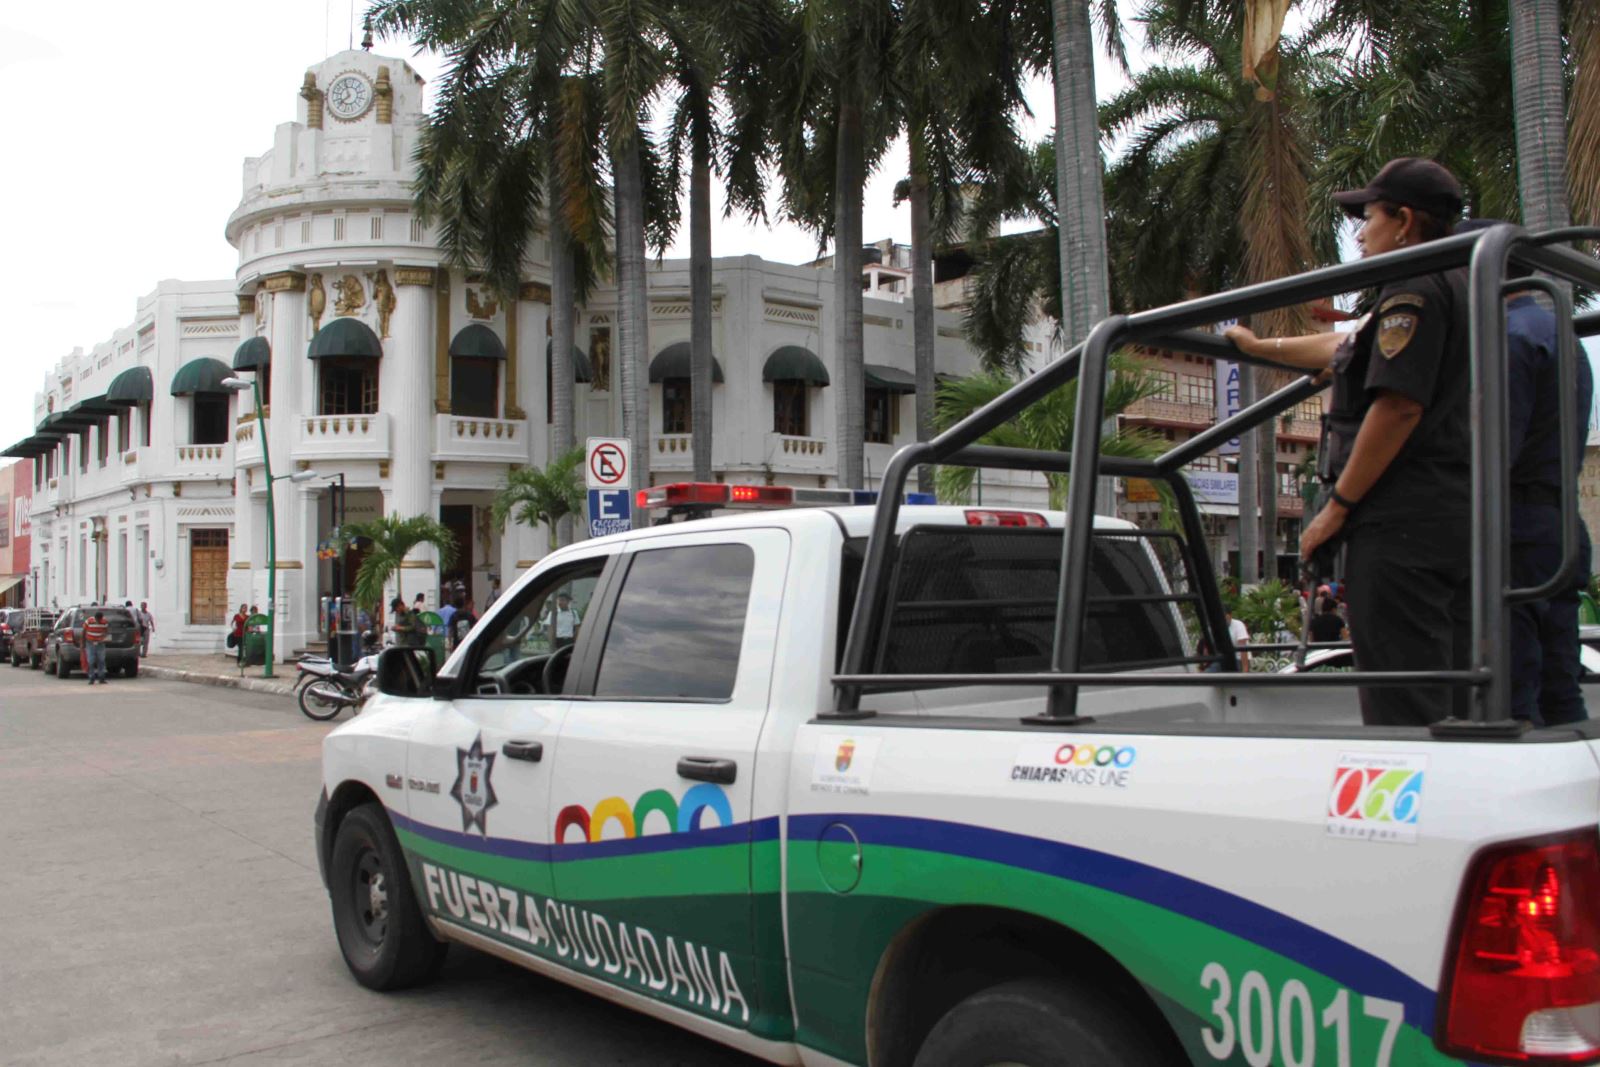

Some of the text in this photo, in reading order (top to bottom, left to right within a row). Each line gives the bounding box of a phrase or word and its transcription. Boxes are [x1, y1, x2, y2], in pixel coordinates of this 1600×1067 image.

[598, 489, 620, 519] E
[1011, 765, 1130, 788] CHIAPAS NOS UNE
[1329, 768, 1424, 823] 066
[422, 862, 750, 1022] FUERZA CIUDADANA
[1200, 961, 1405, 1067] 30017
